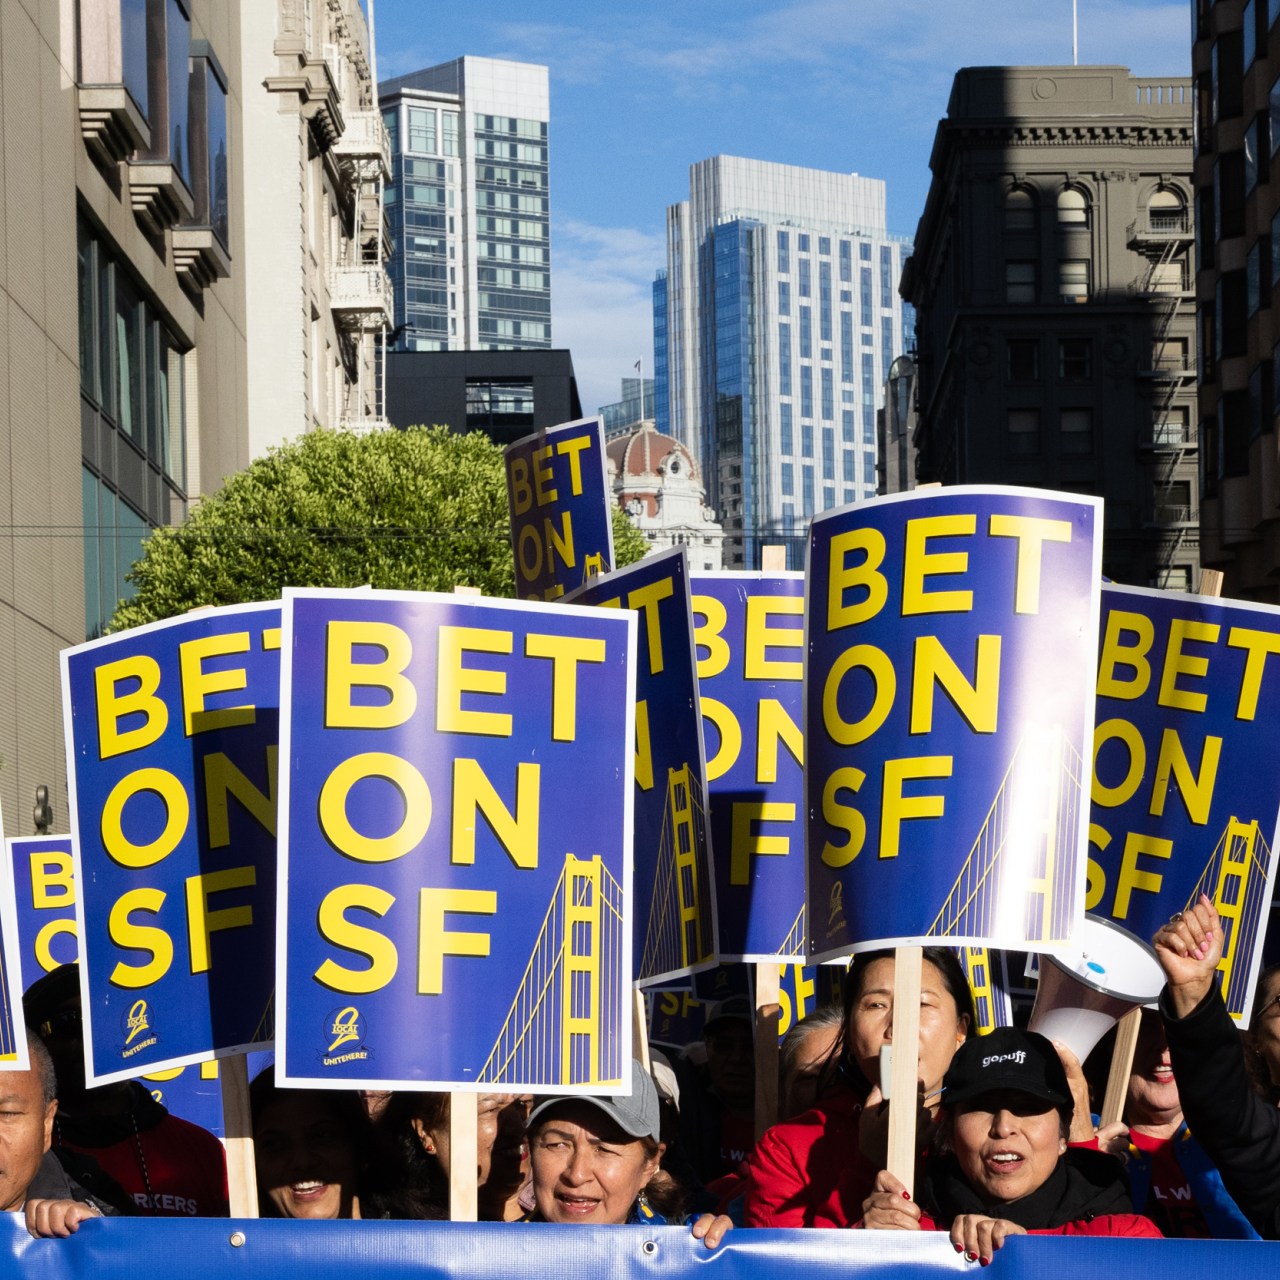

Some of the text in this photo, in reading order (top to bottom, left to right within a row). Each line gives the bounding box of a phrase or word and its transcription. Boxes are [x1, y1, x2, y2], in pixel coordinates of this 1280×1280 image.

[512, 436, 592, 514] BET
[519, 512, 576, 581] ON
[827, 514, 1072, 632] BET
[95, 628, 282, 760] BE
[325, 621, 605, 742] BET
[822, 635, 1002, 746] ON
[101, 745, 278, 869] ON
[319, 753, 541, 869] ON
[822, 756, 953, 868] SF
[1090, 718, 1223, 826] ON
[108, 866, 257, 989] SF
[315, 884, 497, 995] SF
[122, 1037, 156, 1059] UNITEHERE!
[127, 1016, 148, 1027] LOCAL
[323, 1052, 368, 1066] UNITEHERE!
[331, 1024, 358, 1035] LOCAL
[982, 1051, 1027, 1067] gopuff
